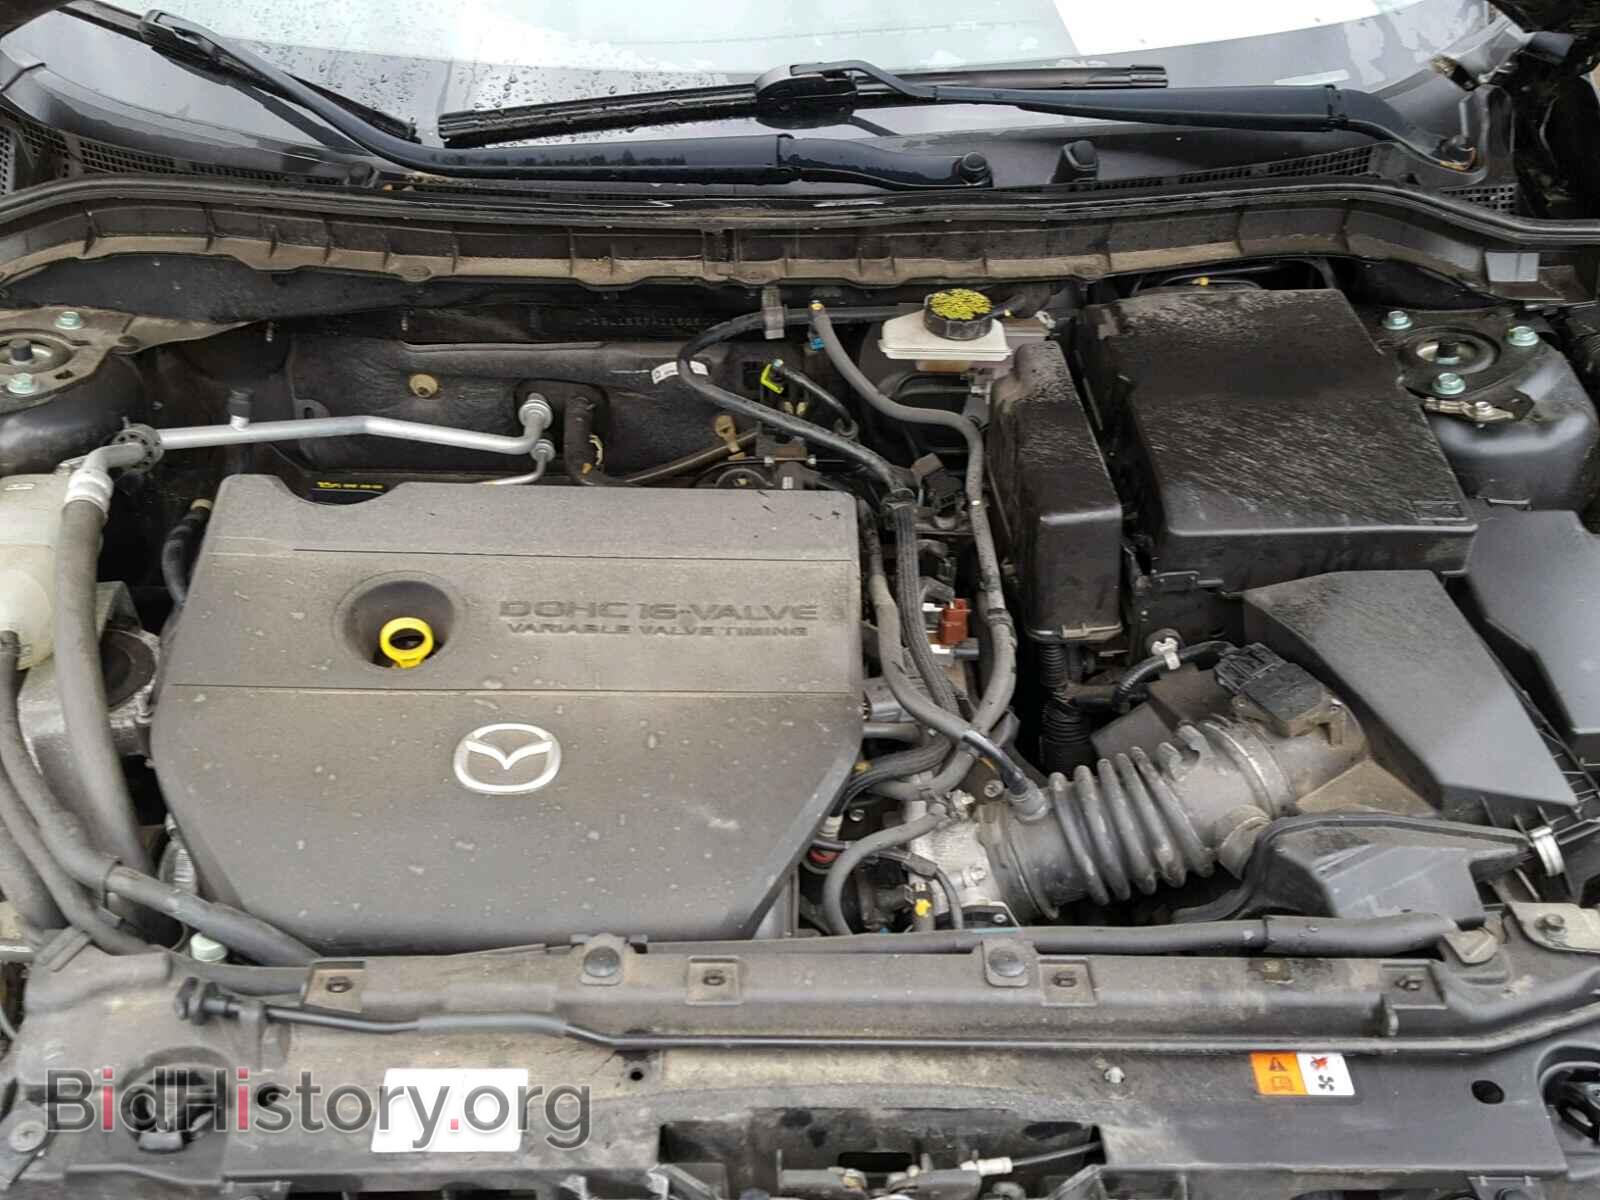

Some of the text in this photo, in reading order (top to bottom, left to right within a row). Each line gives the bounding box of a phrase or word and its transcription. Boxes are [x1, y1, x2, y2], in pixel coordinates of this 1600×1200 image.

[500, 601, 818, 621] DOHC 16-VALVE
[507, 623, 808, 637] VARIABLE VALVE TIMING
